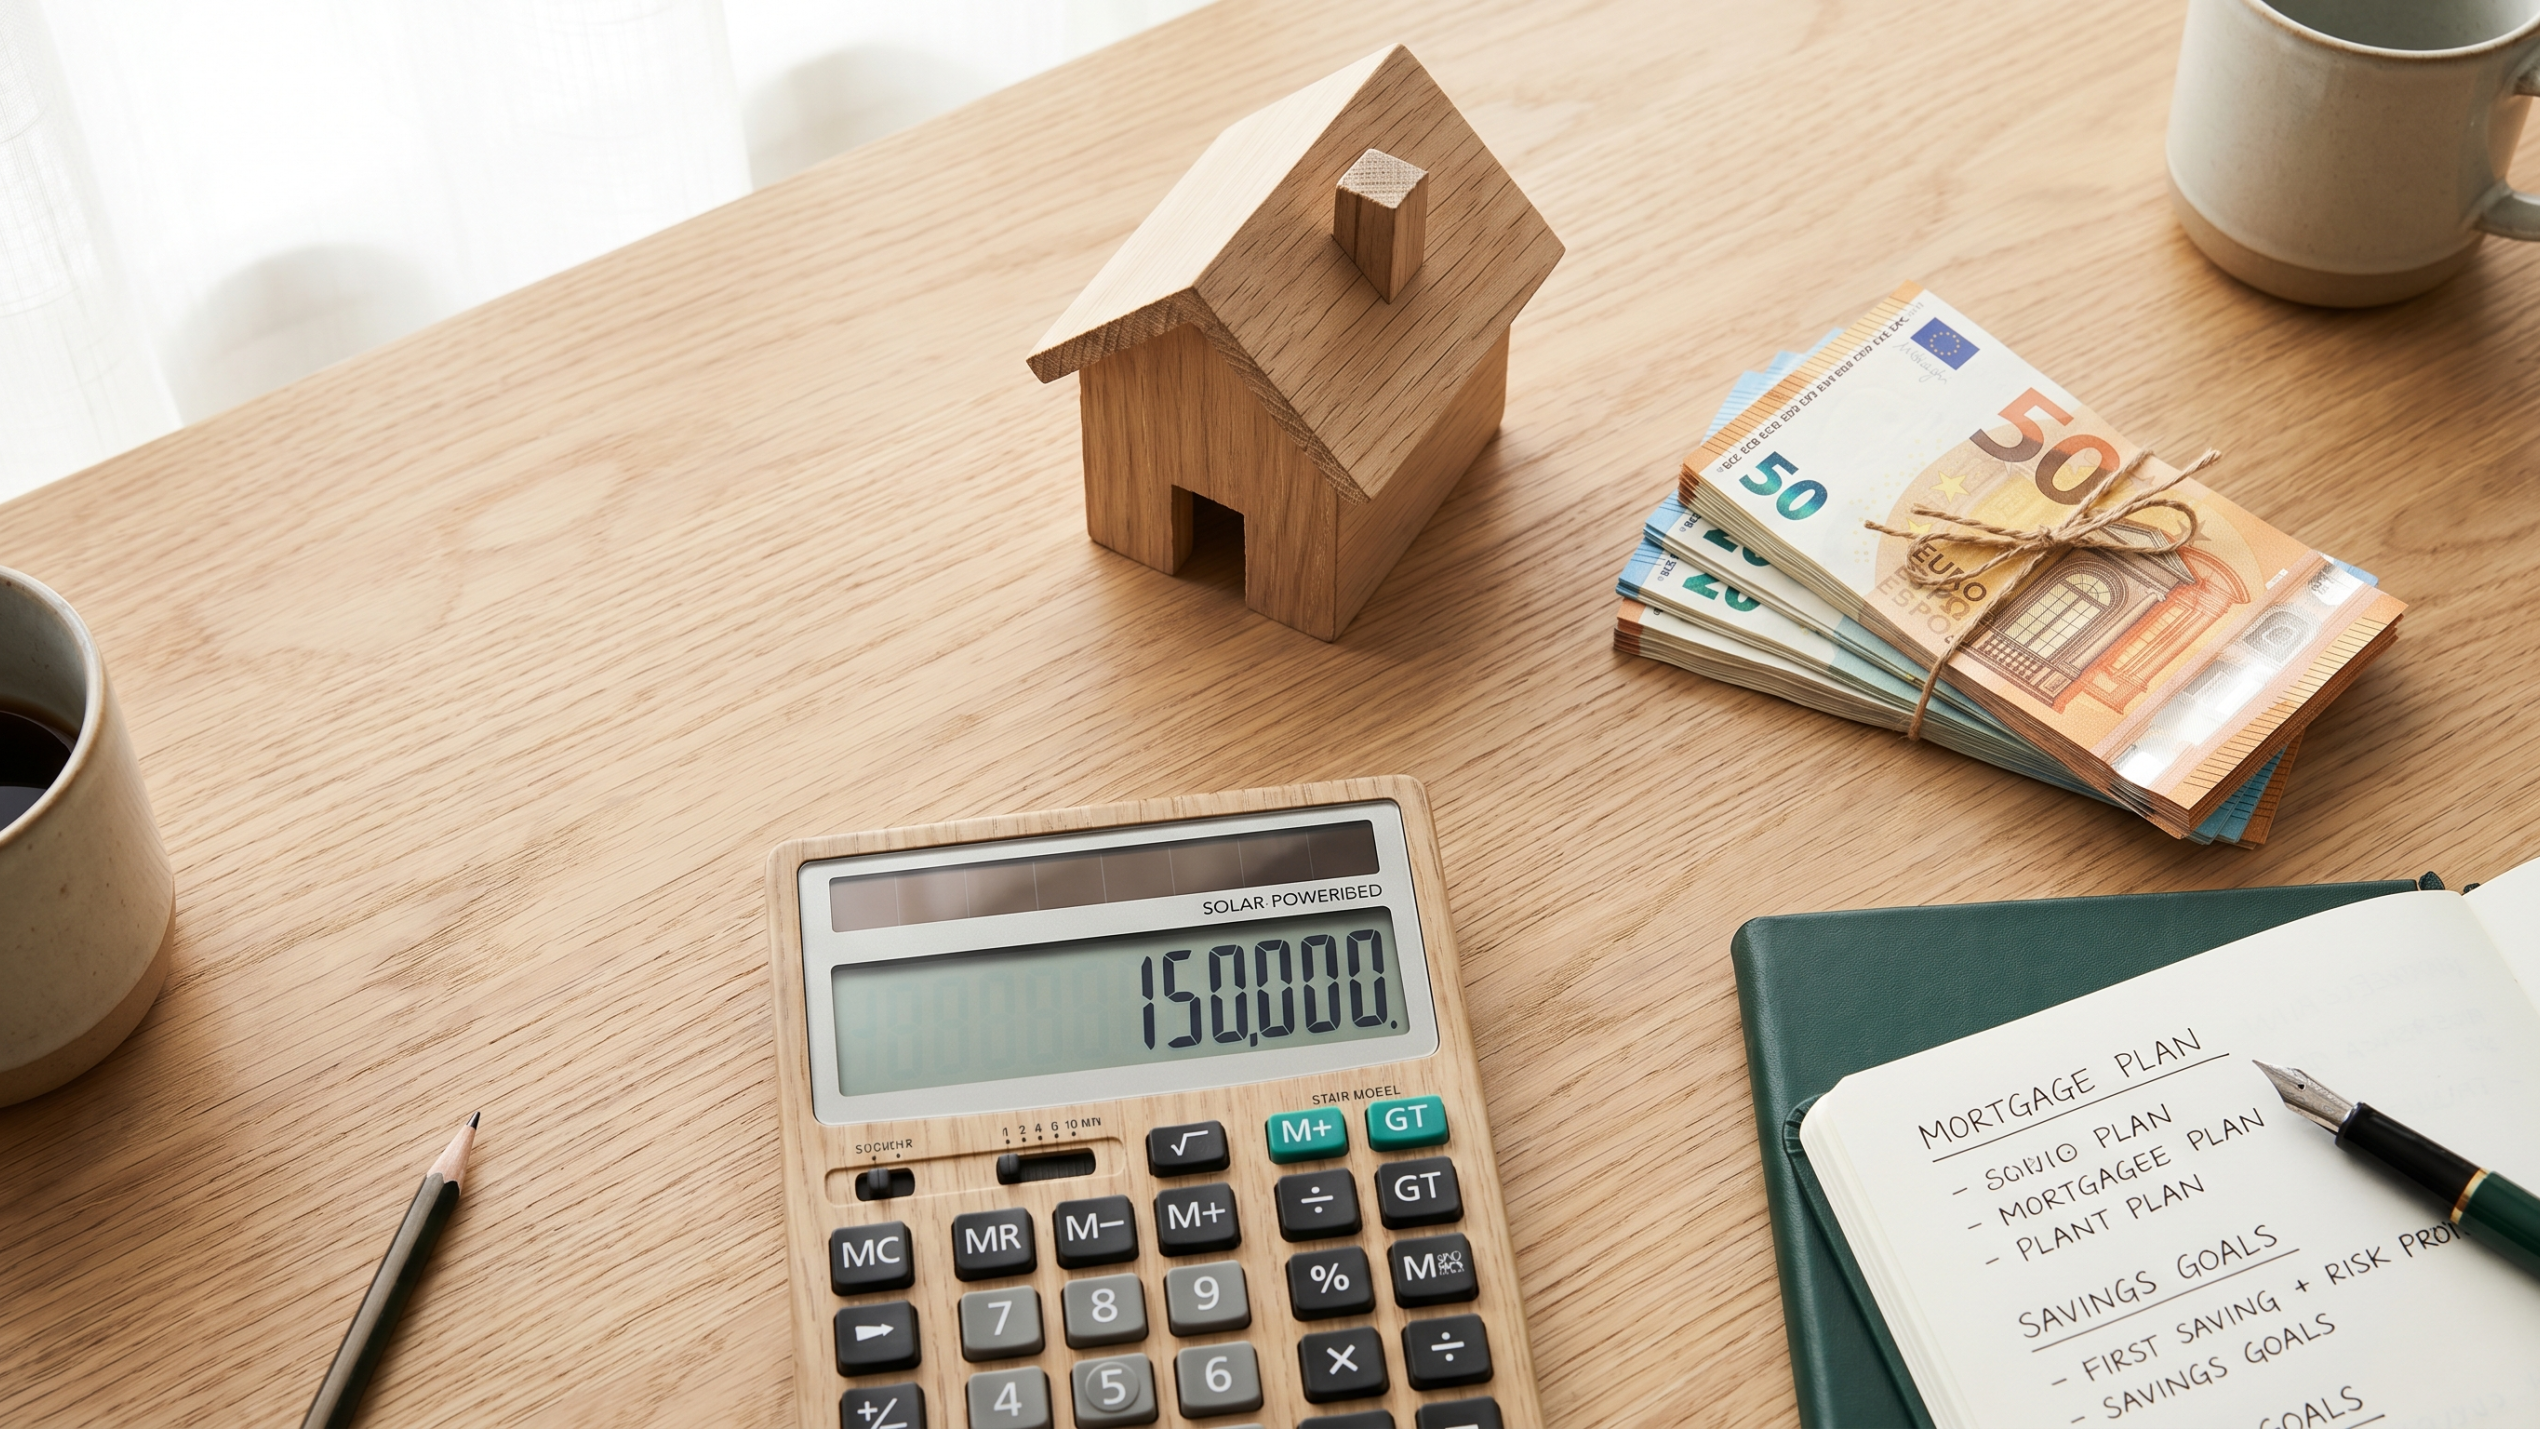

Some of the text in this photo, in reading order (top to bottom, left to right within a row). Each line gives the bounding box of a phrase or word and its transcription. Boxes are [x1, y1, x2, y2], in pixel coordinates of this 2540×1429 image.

[1969, 387, 2121, 506] 50
[1738, 451, 1828, 521] 50
[1202, 896, 1265, 915] SOLAR
[1312, 1085, 1401, 1105] STAIR MOEEL
[1918, 1027, 2201, 1150] MORTGAGE PLAN
[1018, 1125, 1027, 1135] 2
[1034, 1123, 1043, 1133] 4
[1051, 1121, 1059, 1131] 6
[1064, 1119, 1078, 1130] 10
[1281, 1118, 1332, 1143] M+
[1385, 1104, 1428, 1131] GT
[2093, 1103, 2172, 1149] PLAN
[1998, 1107, 2265, 1227] MORTGAGEE PLAN
[1394, 1171, 1441, 1202] GT
[1167, 1201, 1226, 1230] M+
[2016, 1174, 2204, 1261] PLANT PLAN
[842, 1236, 901, 1269] MC
[965, 1224, 1021, 1255] MR
[1193, 1275, 1220, 1311] 9
[1310, 1262, 1350, 1294] %
[2018, 1224, 2278, 1338] SAVINGS GOALS
[988, 1300, 1013, 1336] 7
[1090, 1288, 1119, 1323] 8
[2082, 1334, 2159, 1382] FIRST
[2176, 1290, 2282, 1344] SAVING
[2324, 1246, 2392, 1285] RISK
[1204, 1356, 1233, 1393] 6
[2103, 1313, 2336, 1419] SAVINGS GOALS
[993, 1382, 1023, 1417] 4
[1099, 1368, 1127, 1406] 5
